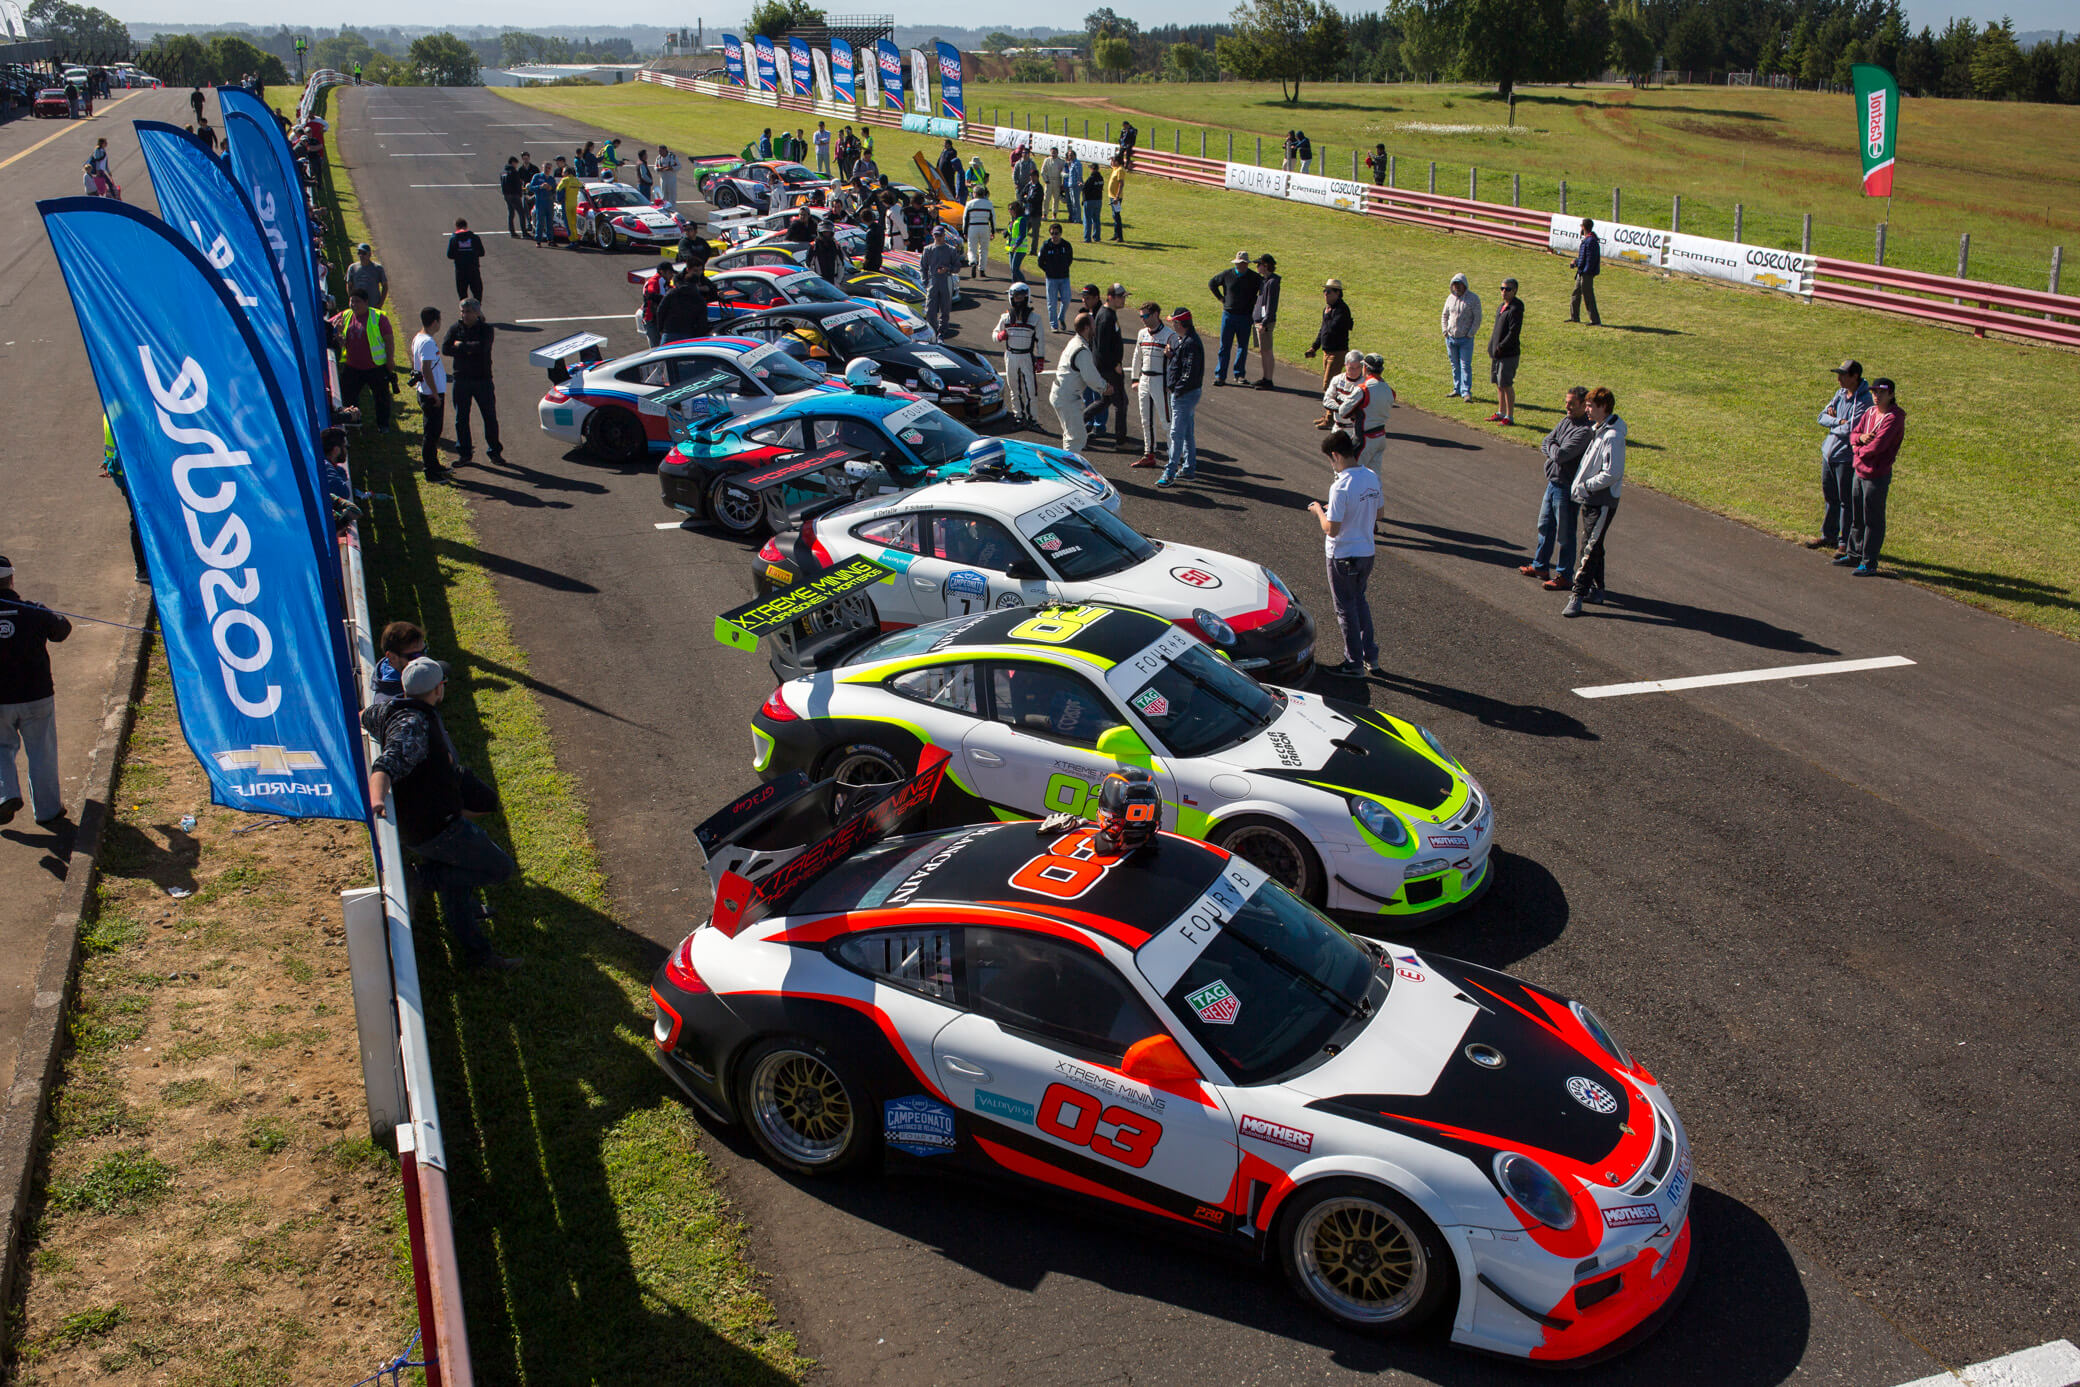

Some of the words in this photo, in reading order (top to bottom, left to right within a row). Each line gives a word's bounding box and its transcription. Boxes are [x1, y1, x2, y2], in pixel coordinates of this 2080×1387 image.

[1230, 168, 1264, 188] FOUR
[1291, 185, 1327, 196] CAMARO
[1552, 228, 1607, 244] CAMO
[1672, 249, 1737, 267] CAMARO
[649, 373, 730, 405] PORSCHE
[747, 449, 849, 484] PORSCHE
[1037, 502, 1069, 522] FOUR
[730, 586, 818, 629] XTREME
[810, 561, 873, 592] MINING
[765, 594, 828, 625] HORMIGONES
[823, 587, 835, 597] Y
[833, 568, 883, 593] MORTEROS
[1135, 642, 1176, 674] FOUR
[1137, 691, 1158, 706] TAG
[1267, 732, 1293, 766] BECKER
[1276, 732, 1302, 767] CARBON
[1125, 804, 1155, 821] 01
[746, 818, 861, 905] XTREME
[863, 771, 934, 831] MINING
[1180, 891, 1233, 945] FOUR
[1231, 872, 1250, 888] B
[1193, 985, 1227, 1007] TAG
[1201, 997, 1237, 1020] HEUER
[1055, 1060, 1117, 1091] XTREME
[1118, 1085, 1167, 1110] MINING
[887, 1110, 952, 1133] CAMPEONATO
[1036, 1081, 1163, 1169] 03
[1242, 1116, 1312, 1147] MOTHERS
[1193, 1206, 1225, 1219] PRO
[1603, 1205, 1658, 1222] MOTHERS
